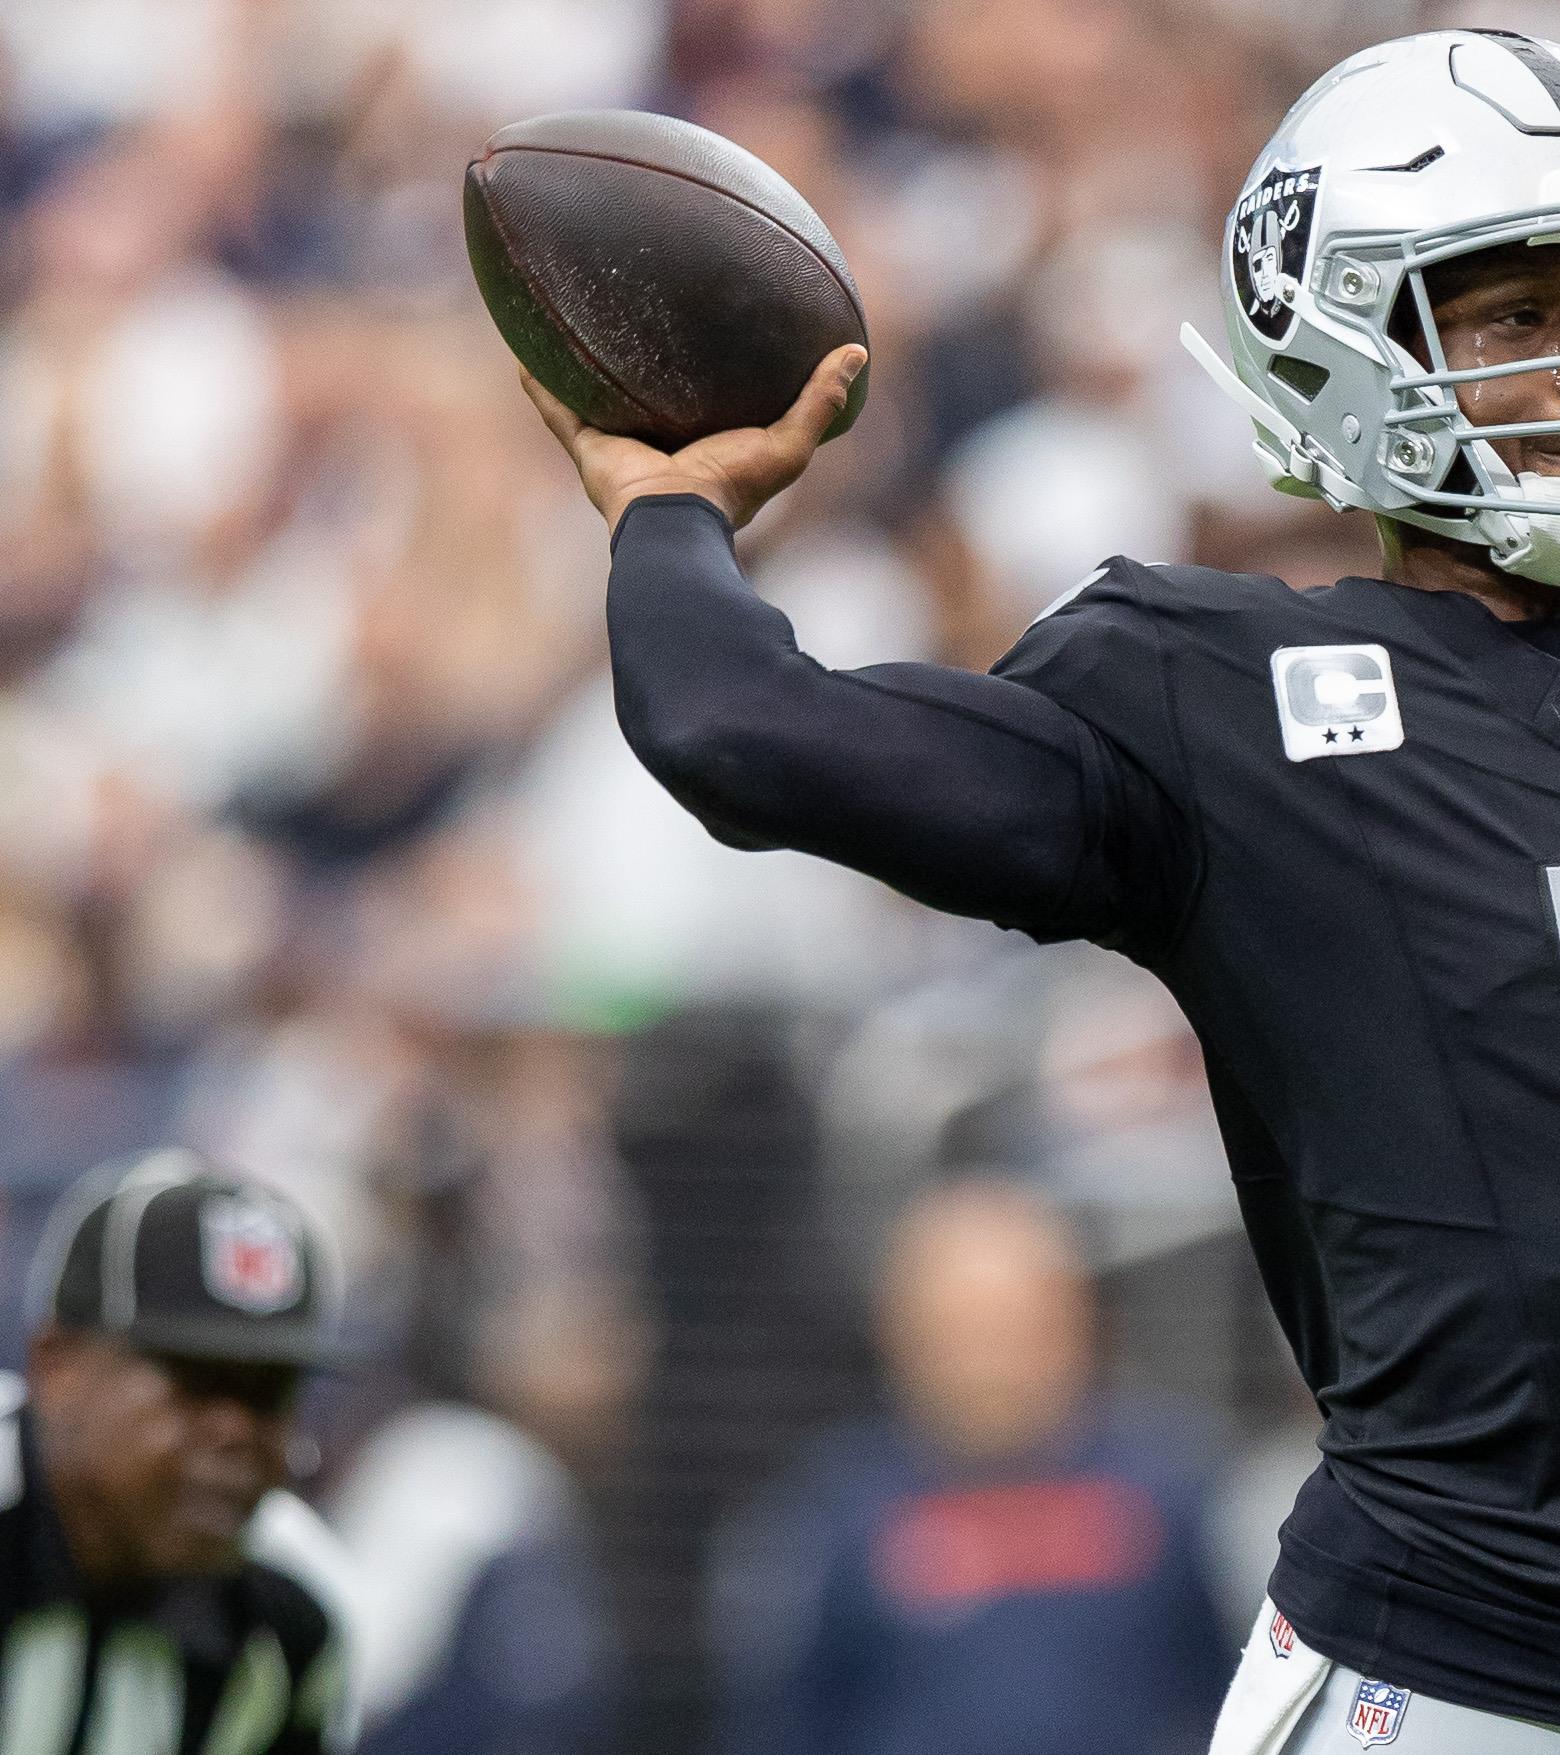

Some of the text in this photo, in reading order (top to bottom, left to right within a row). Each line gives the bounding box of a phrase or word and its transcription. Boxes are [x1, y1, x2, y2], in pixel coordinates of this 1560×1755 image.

[1240, 173, 1309, 220] RAIDERS
[1285, 653, 1387, 726] C
[1354, 1704, 1390, 1734] NFL
